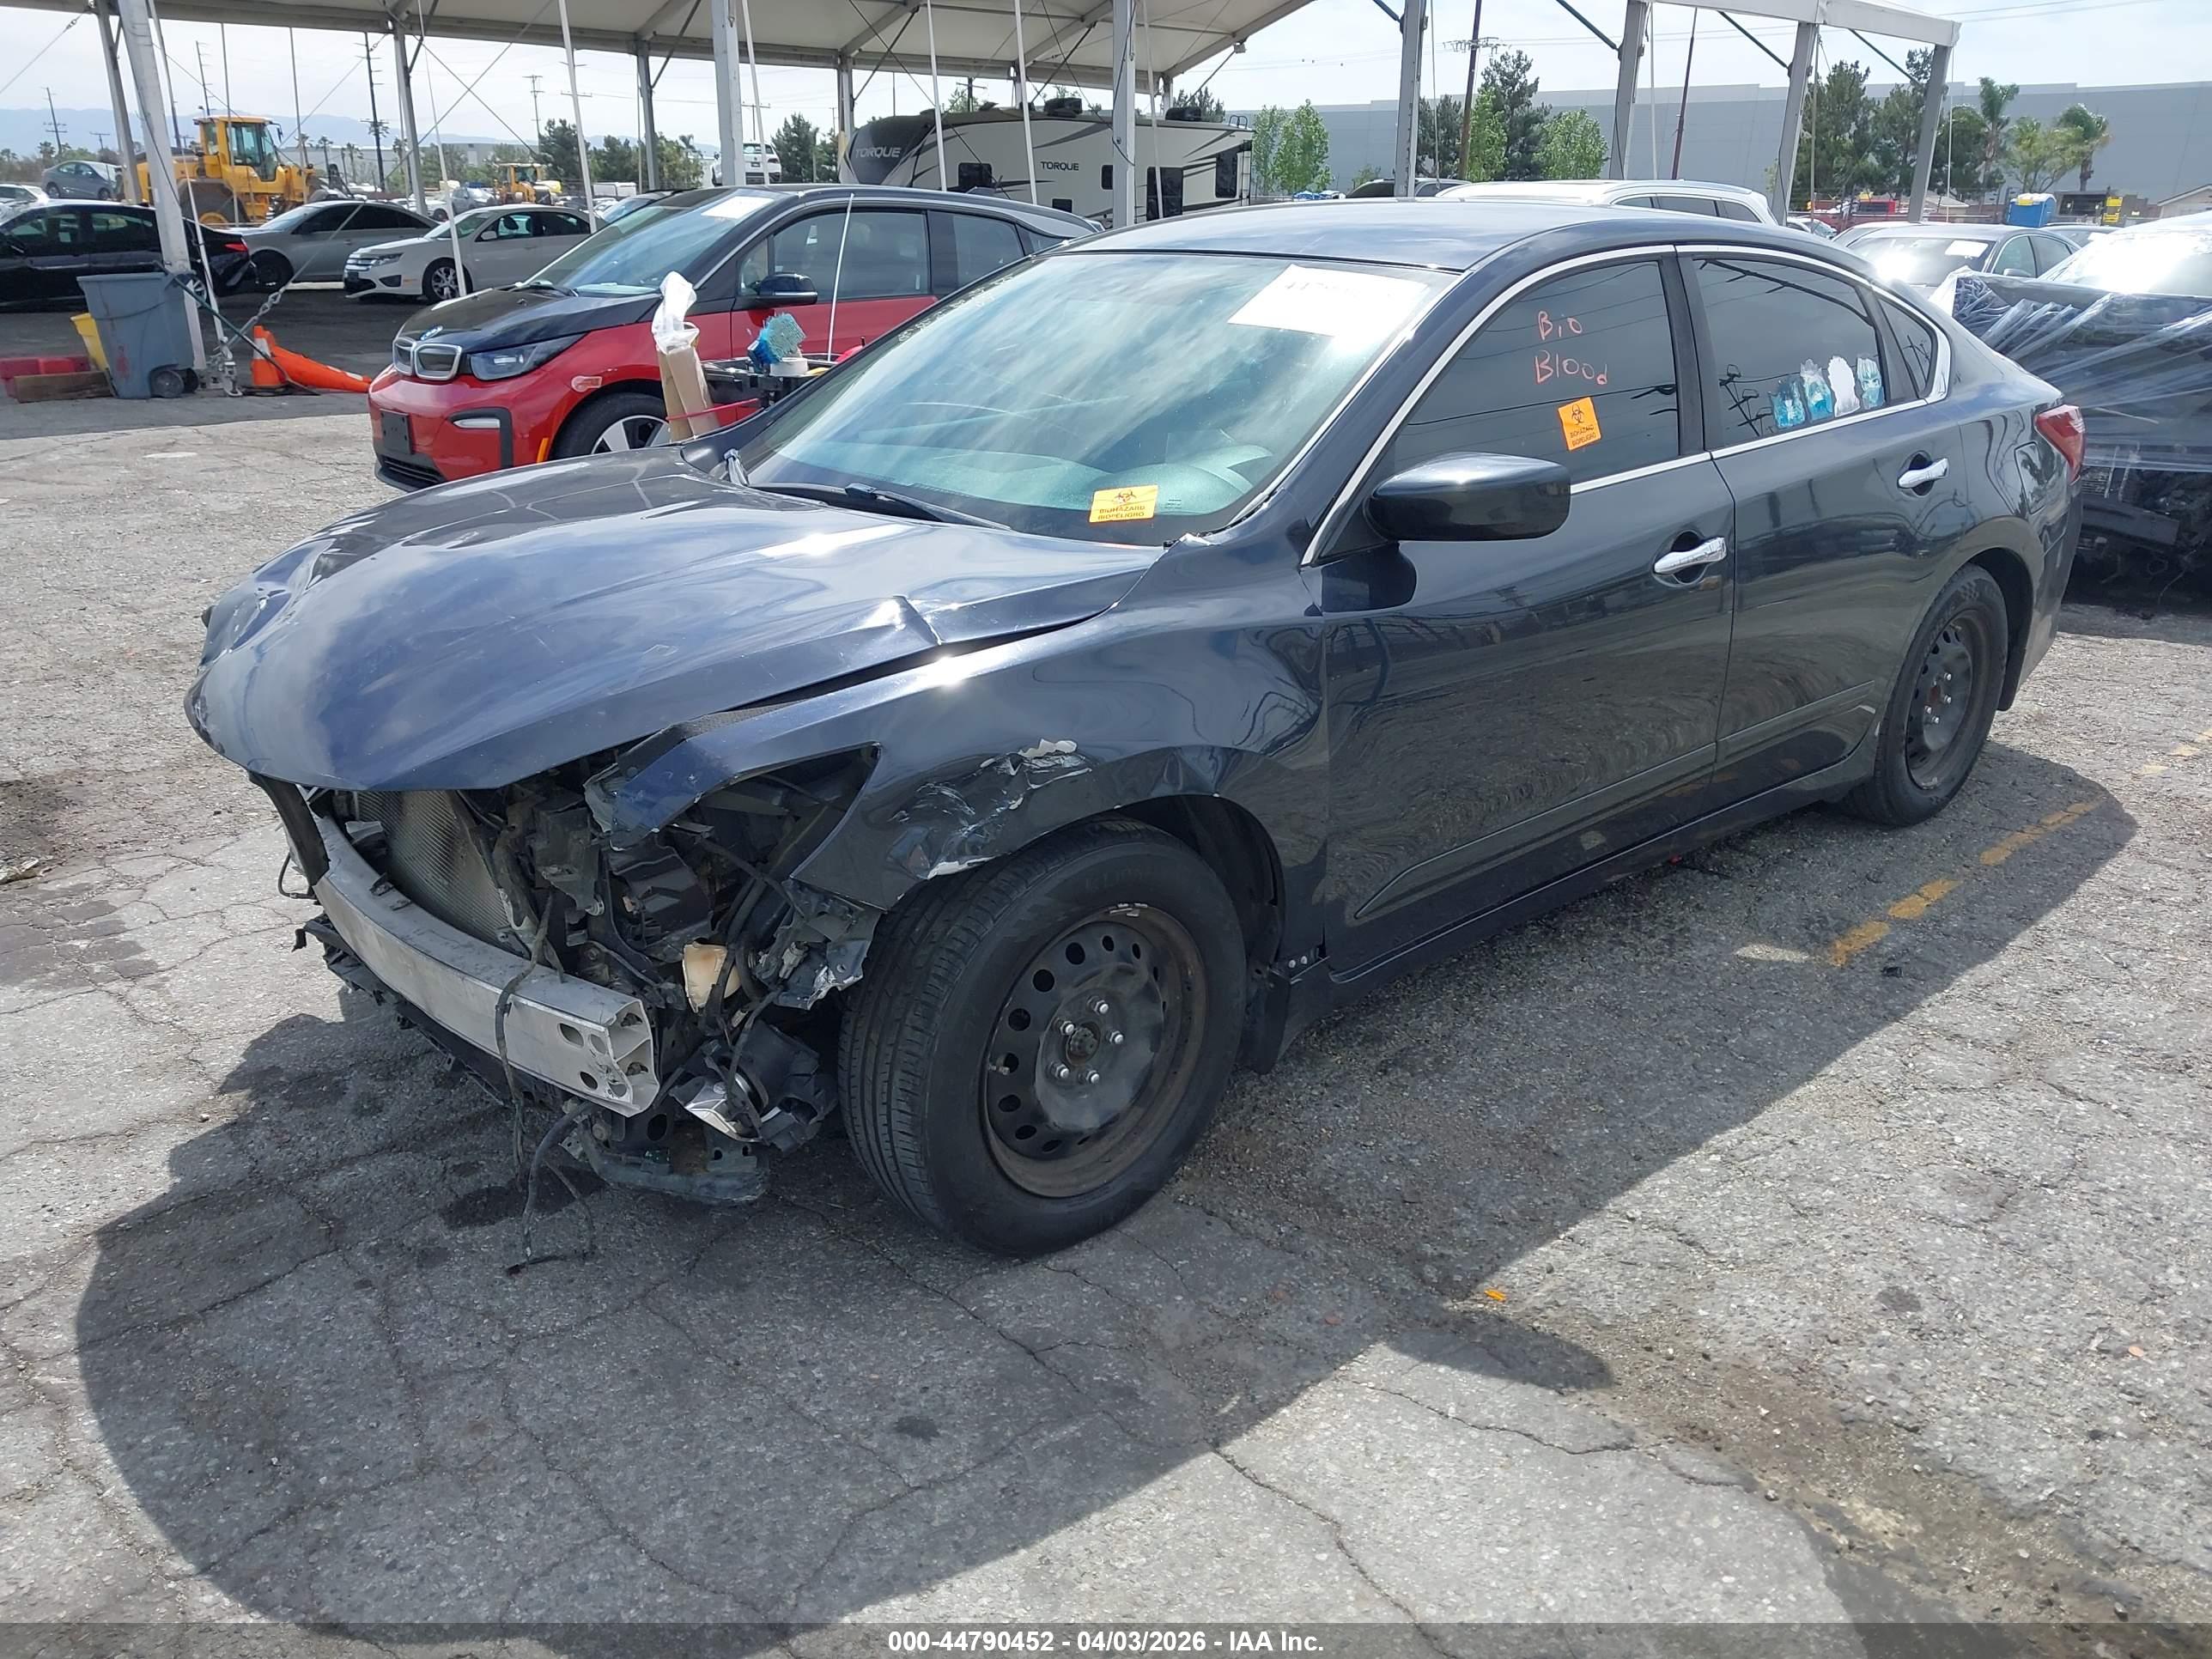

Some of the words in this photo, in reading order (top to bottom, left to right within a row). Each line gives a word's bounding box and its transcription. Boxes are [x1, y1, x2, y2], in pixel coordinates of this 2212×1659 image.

[855, 147, 902, 158] TORQUE
[1040, 161, 1079, 171] TORQUE
[1534, 349, 1607, 385] Blood
[1099, 505, 1146, 514] BIOHAZARD
